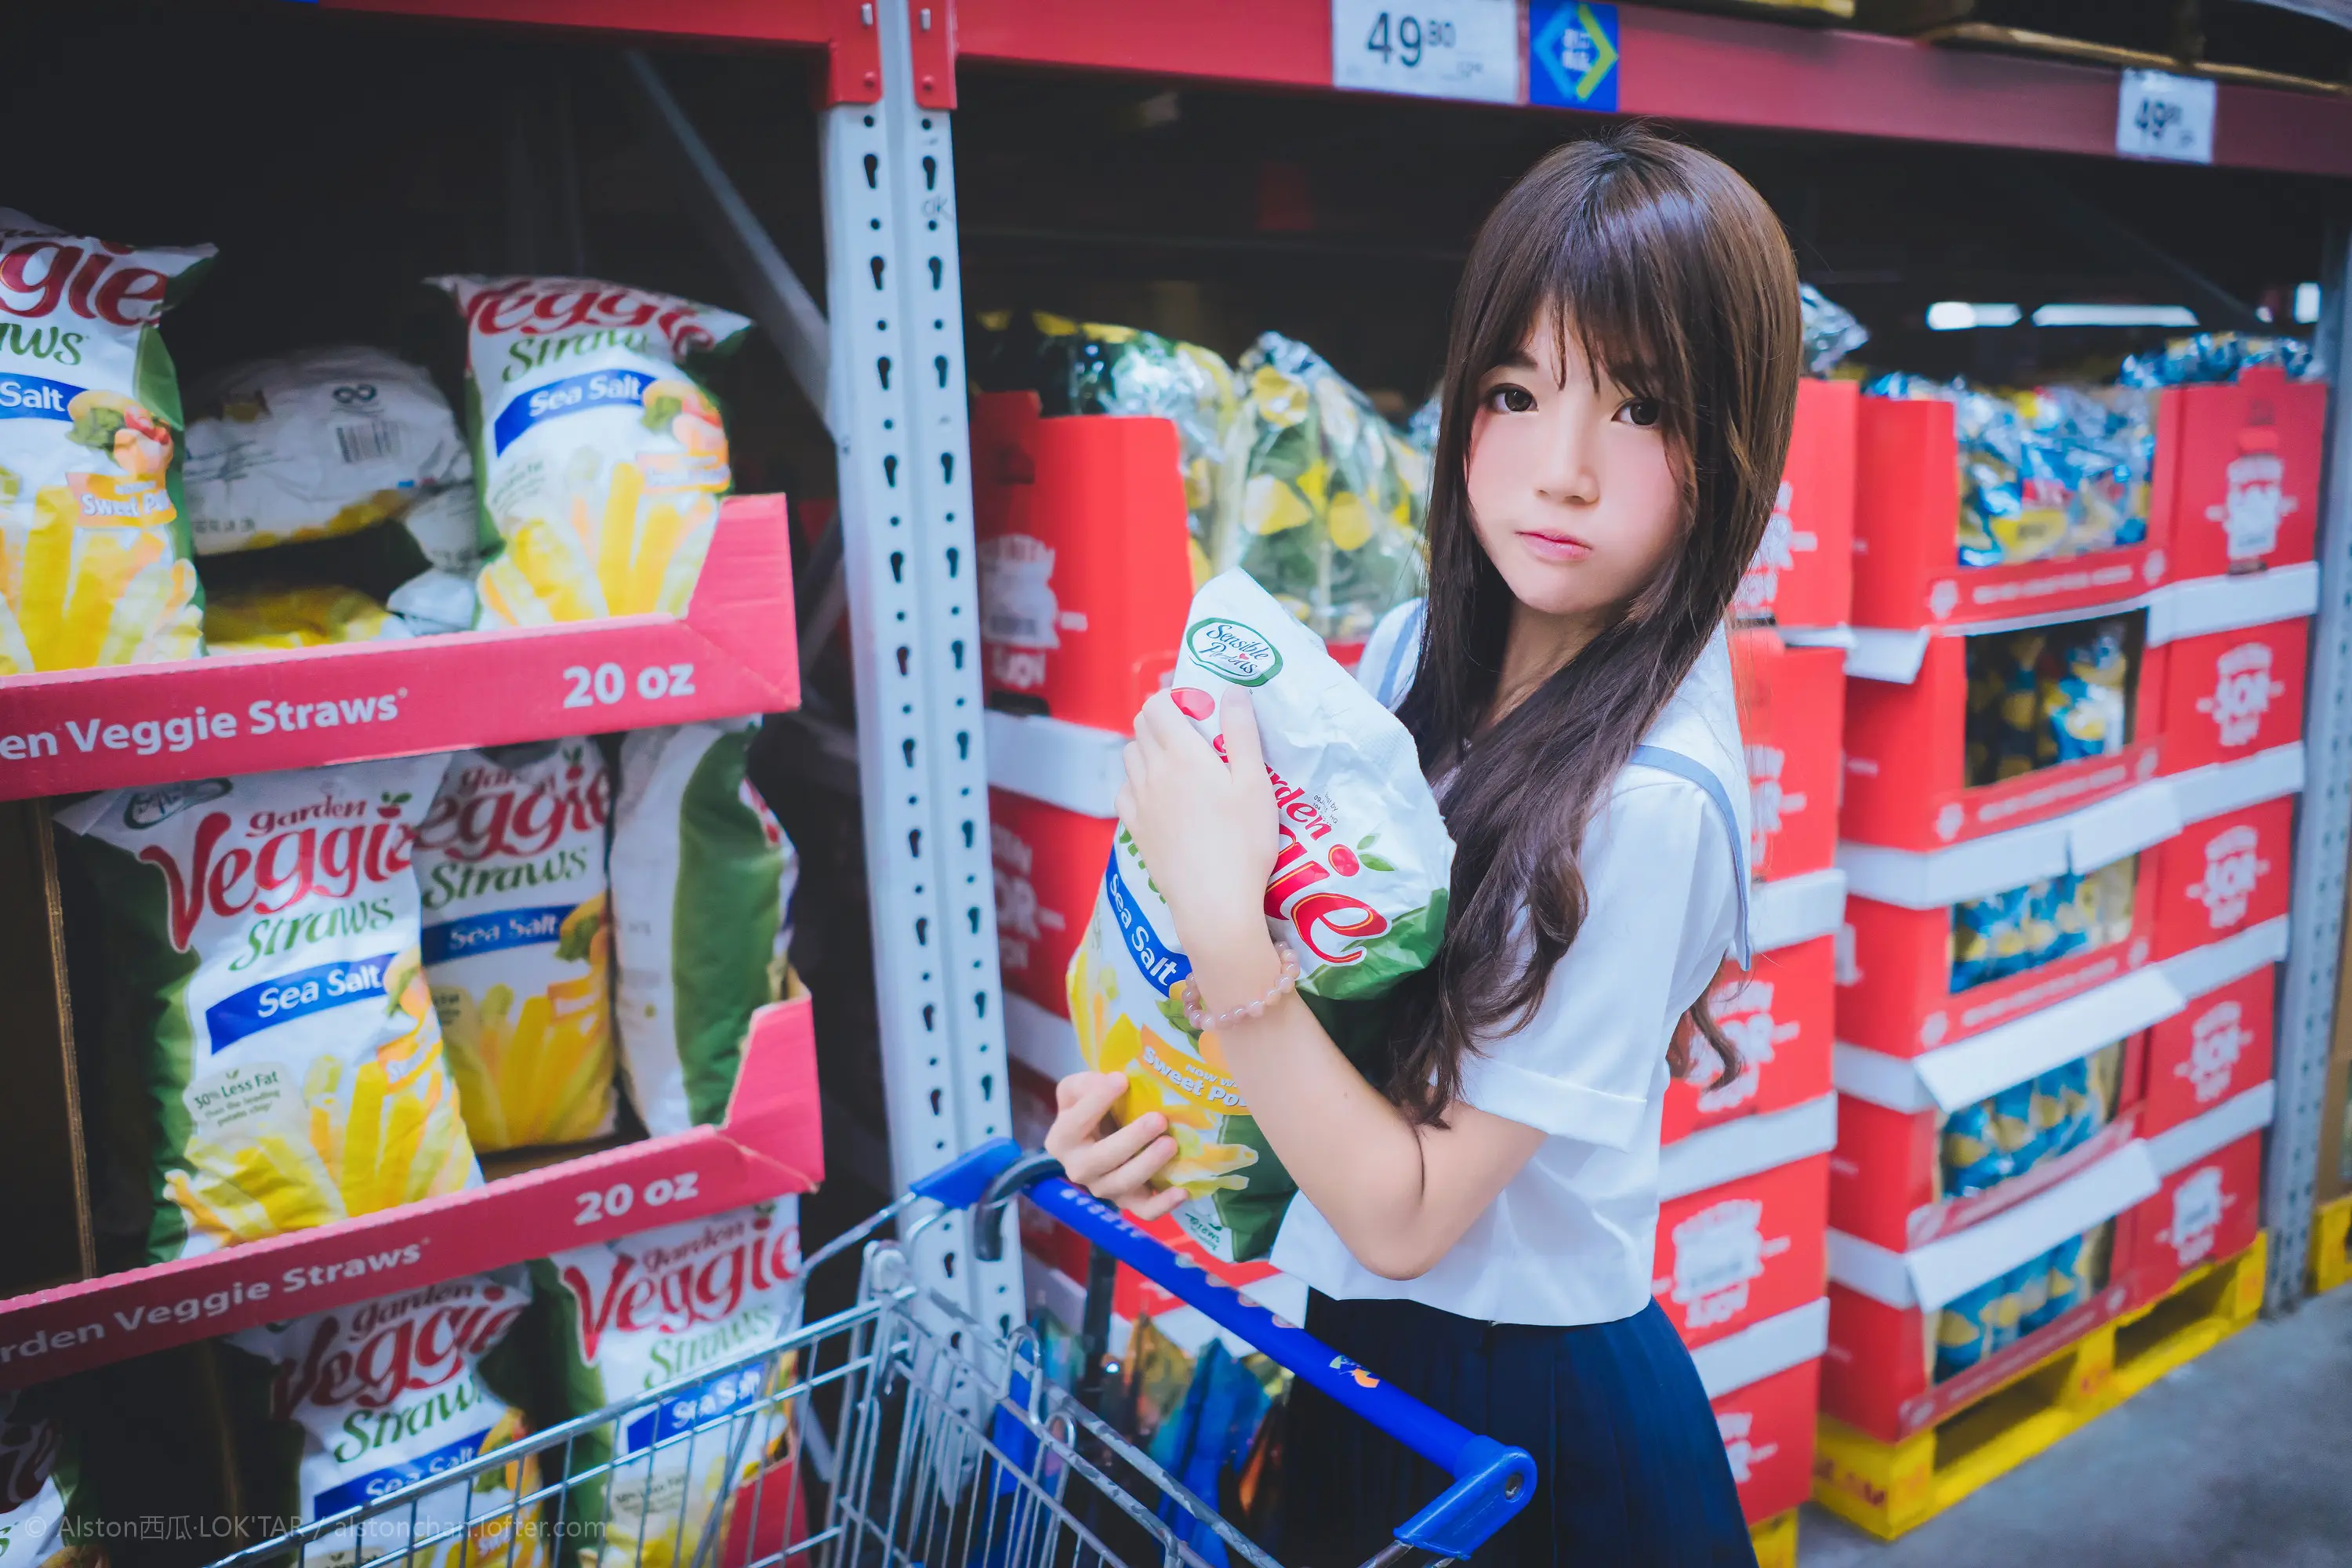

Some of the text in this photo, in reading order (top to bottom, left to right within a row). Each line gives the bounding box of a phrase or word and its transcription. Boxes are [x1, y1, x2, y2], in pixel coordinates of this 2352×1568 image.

[1365, 12, 1423, 67] 49
[0, 381, 65, 419] Salt
[529, 374, 642, 418] Sea Salt
[1206, 624, 1269, 660] Sensible
[563, 662, 695, 708] 20 oz
[65, 706, 236, 756] Veggie
[249, 692, 399, 736] Straws
[245, 794, 368, 838] garden
[423, 846, 587, 910] Straws
[228, 896, 394, 971] Straws
[1110, 873, 1133, 930] Sea
[1131, 926, 1178, 986] Salt
[257, 964, 383, 1018] Sea Salt
[1142, 1045, 1204, 1098] Sweet
[574, 1172, 699, 1226] 20 oz
[114, 1281, 270, 1331] Veggie
[282, 1242, 421, 1294] Straws
[562, 1217, 800, 1362] Veggie
